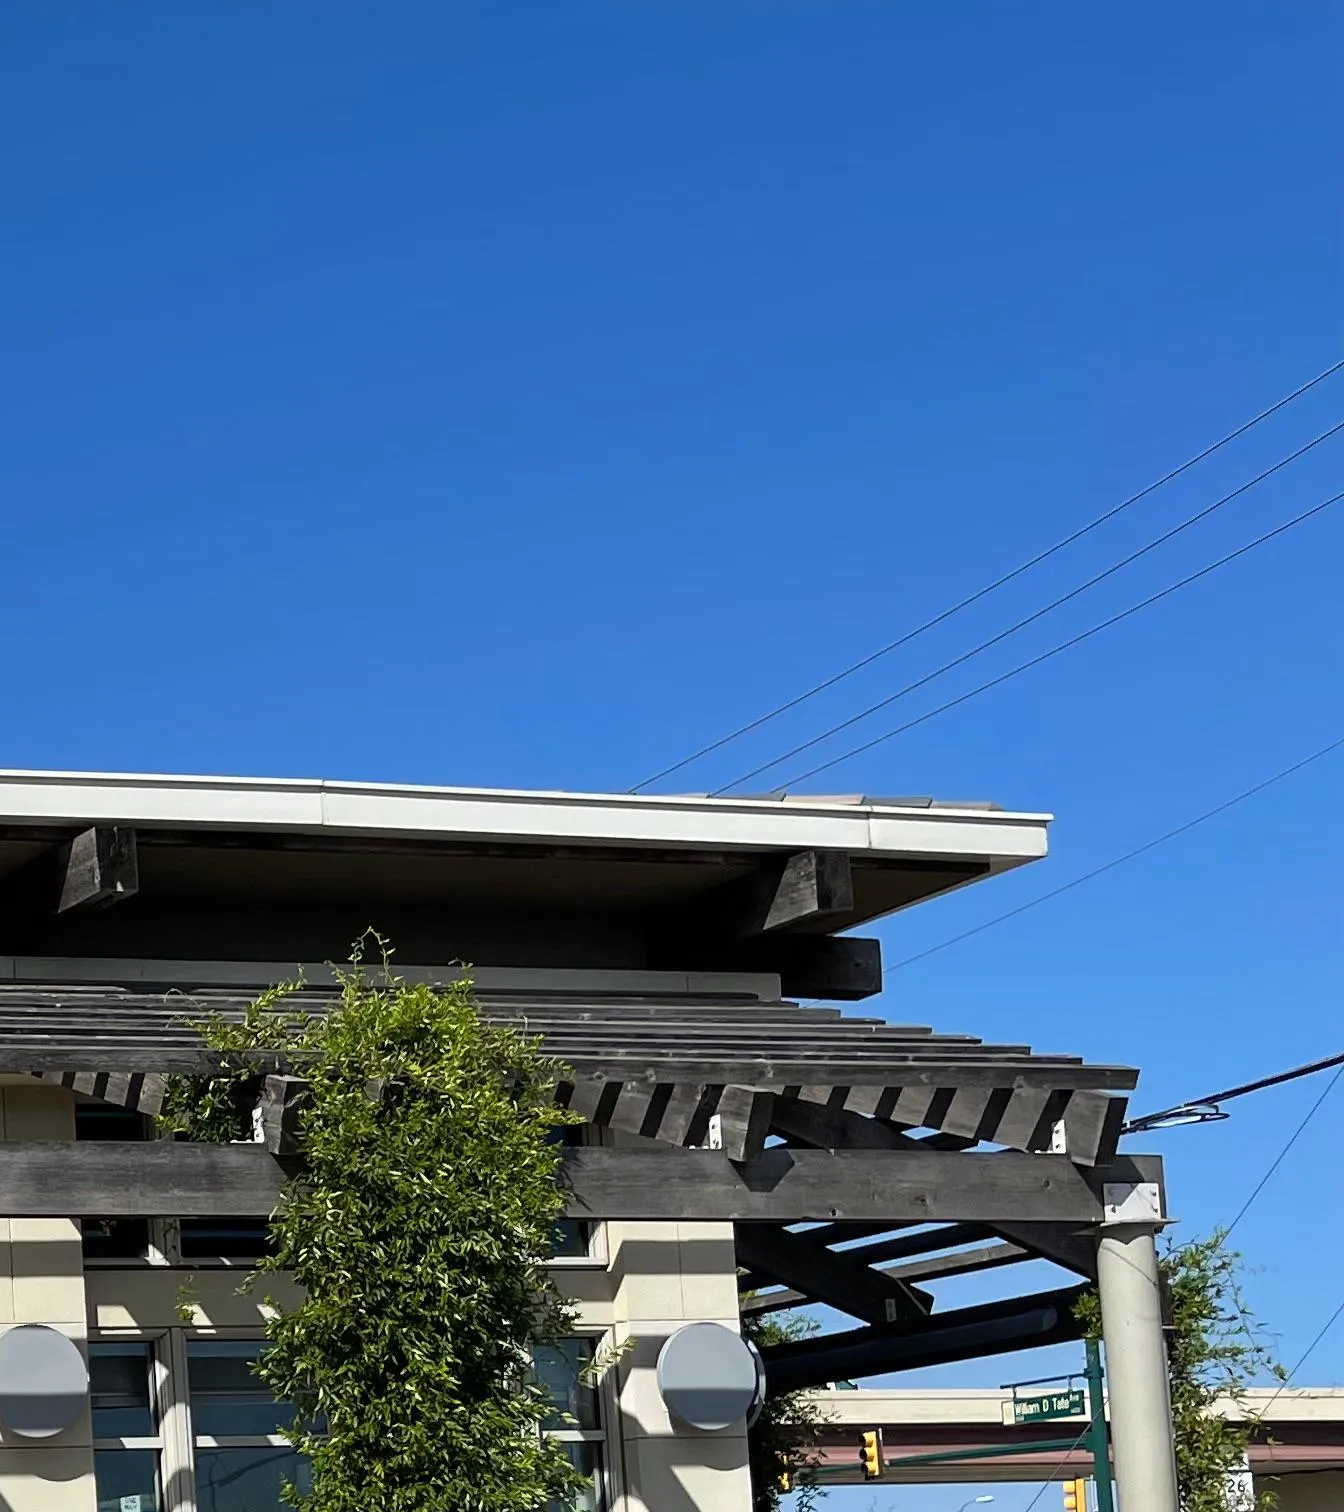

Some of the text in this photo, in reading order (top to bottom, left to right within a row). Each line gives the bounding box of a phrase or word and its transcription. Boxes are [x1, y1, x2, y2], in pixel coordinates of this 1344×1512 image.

[1015, 1402, 1041, 1416] William
[1042, 1398, 1050, 1413] D
[1227, 1479, 1246, 1493] 26
